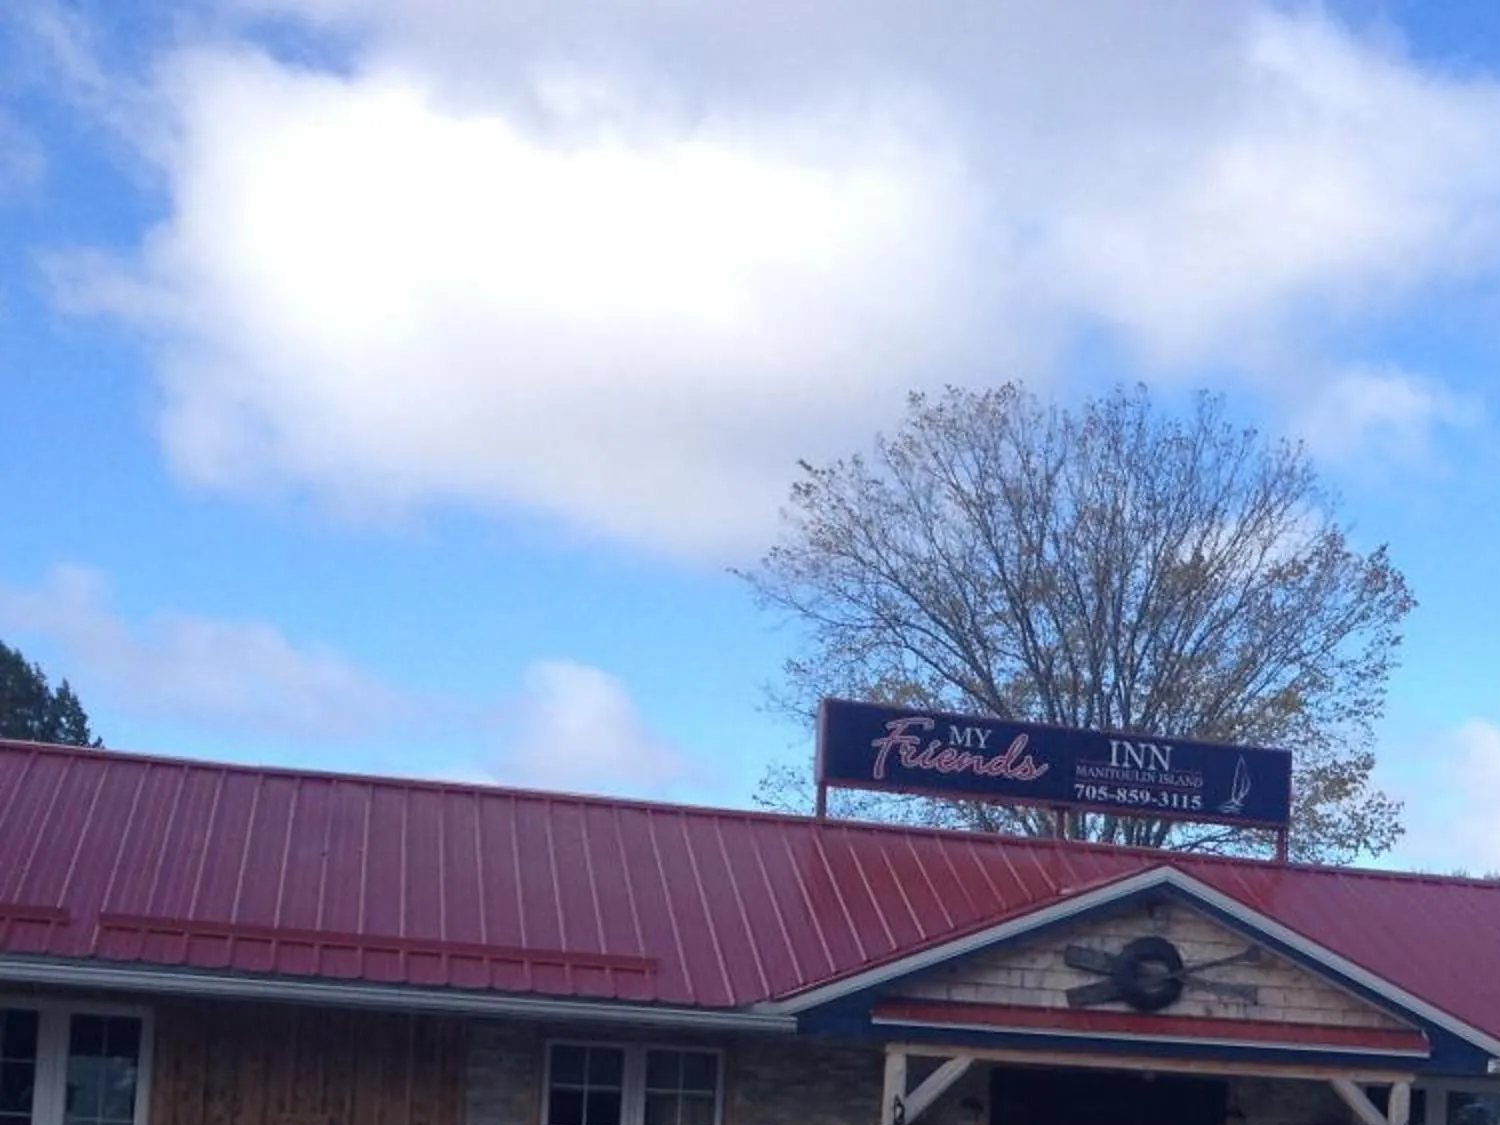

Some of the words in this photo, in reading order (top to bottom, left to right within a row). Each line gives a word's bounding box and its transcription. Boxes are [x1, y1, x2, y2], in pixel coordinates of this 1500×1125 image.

[872, 717, 1048, 780] Friends
[949, 725, 992, 749] MY
[1109, 739, 1174, 772] INN
[1075, 764, 1156, 783] MANITOULIN
[1159, 773, 1203, 789] ISLAND
[1073, 783, 1202, 810] 705-859-3115
